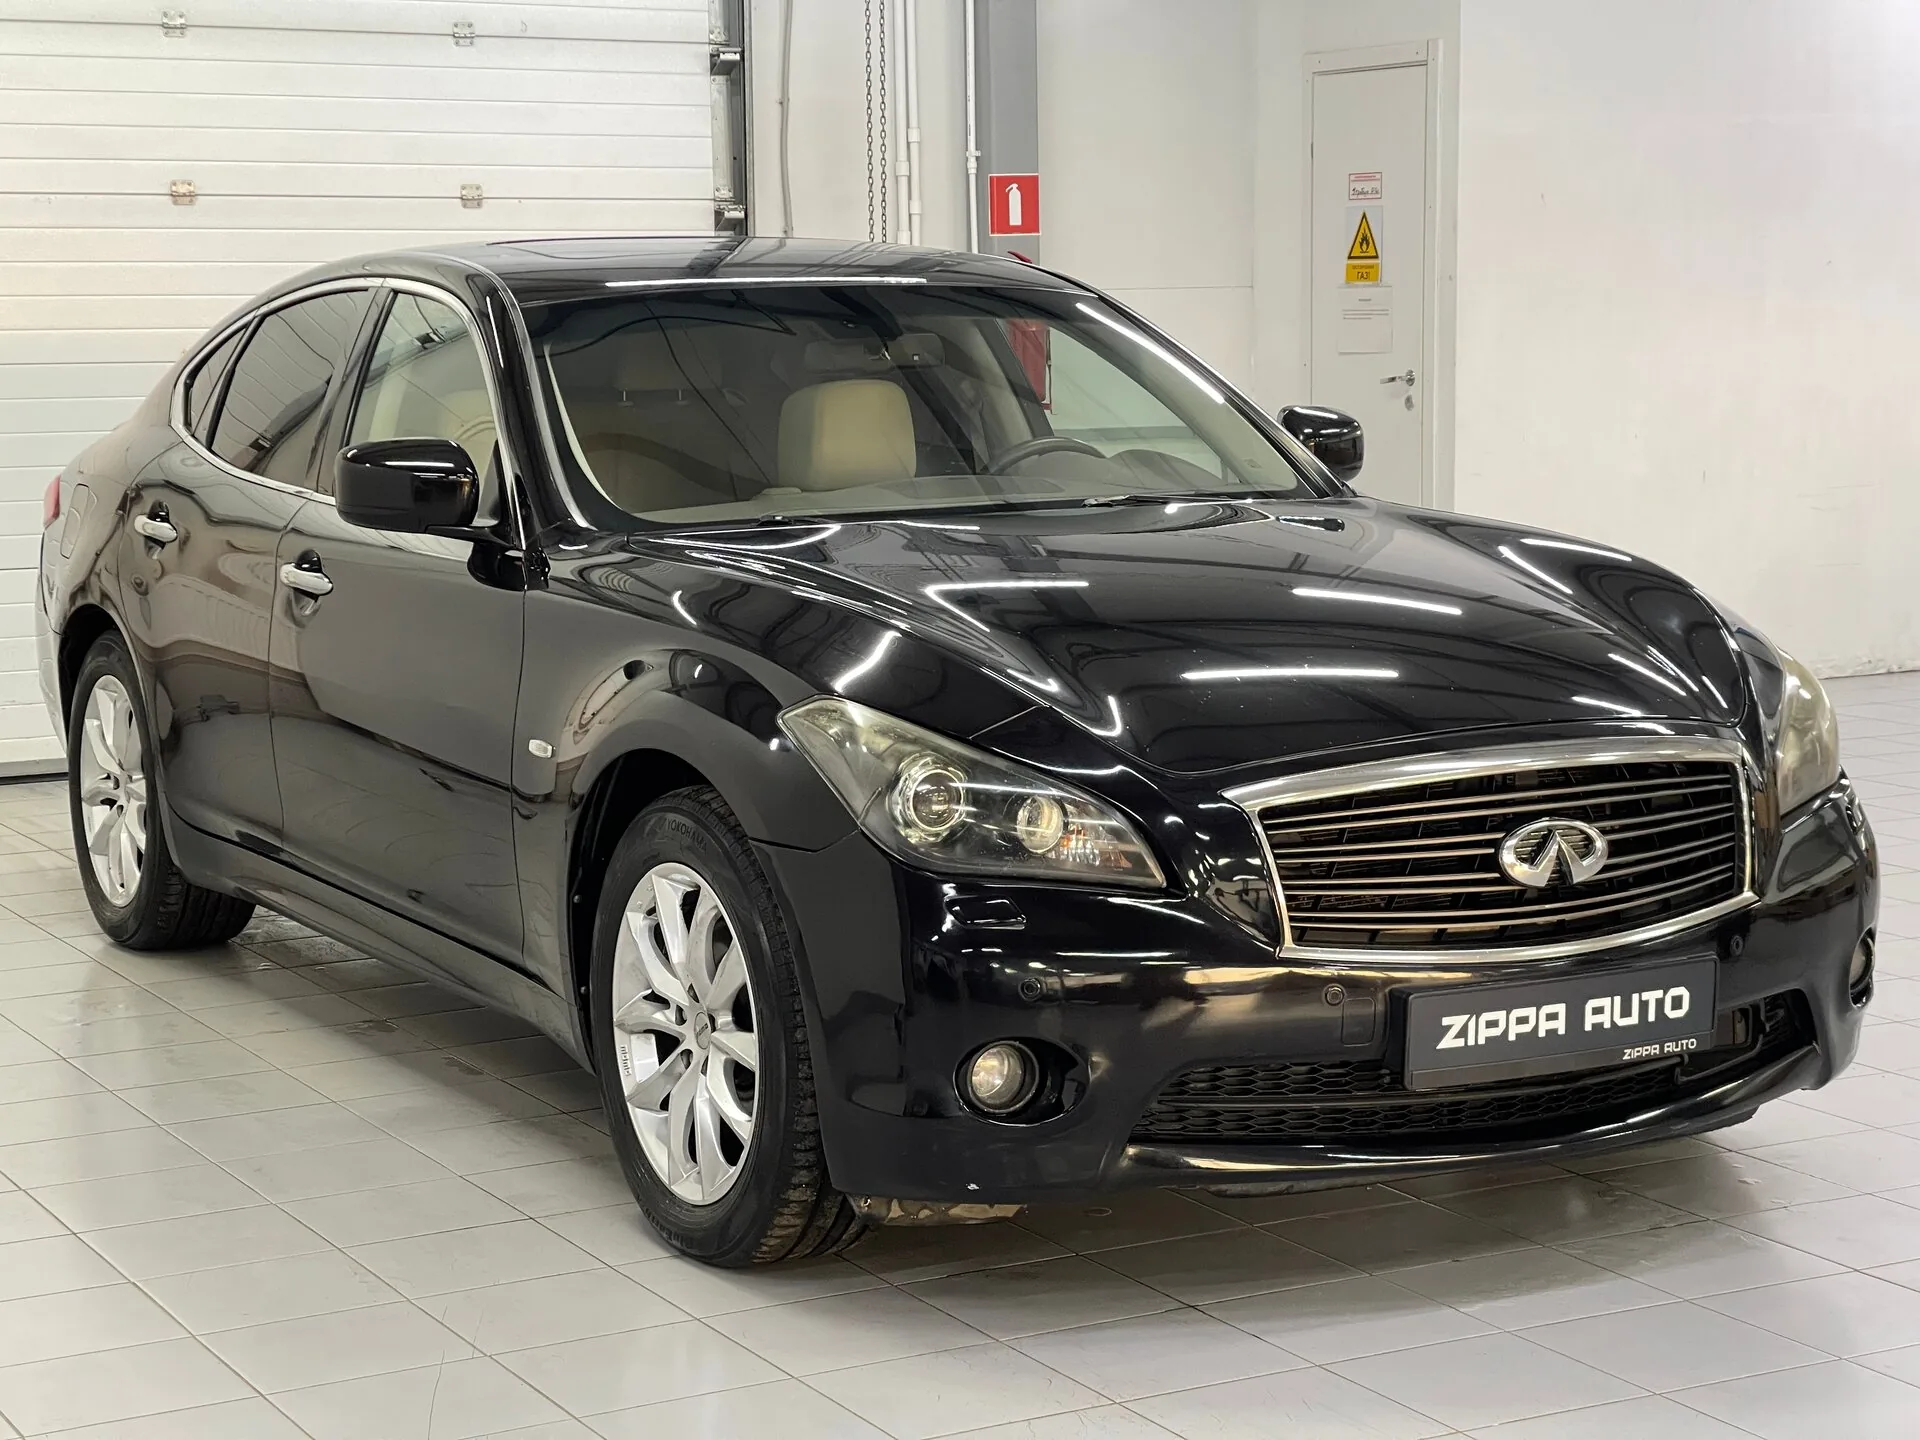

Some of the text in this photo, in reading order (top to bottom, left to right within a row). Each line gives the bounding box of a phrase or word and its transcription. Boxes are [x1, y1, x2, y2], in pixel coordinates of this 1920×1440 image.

[1436, 987, 1689, 1049] ZIPPA AUTO
[1623, 1039, 1696, 1060] ZIPPA AUTO
